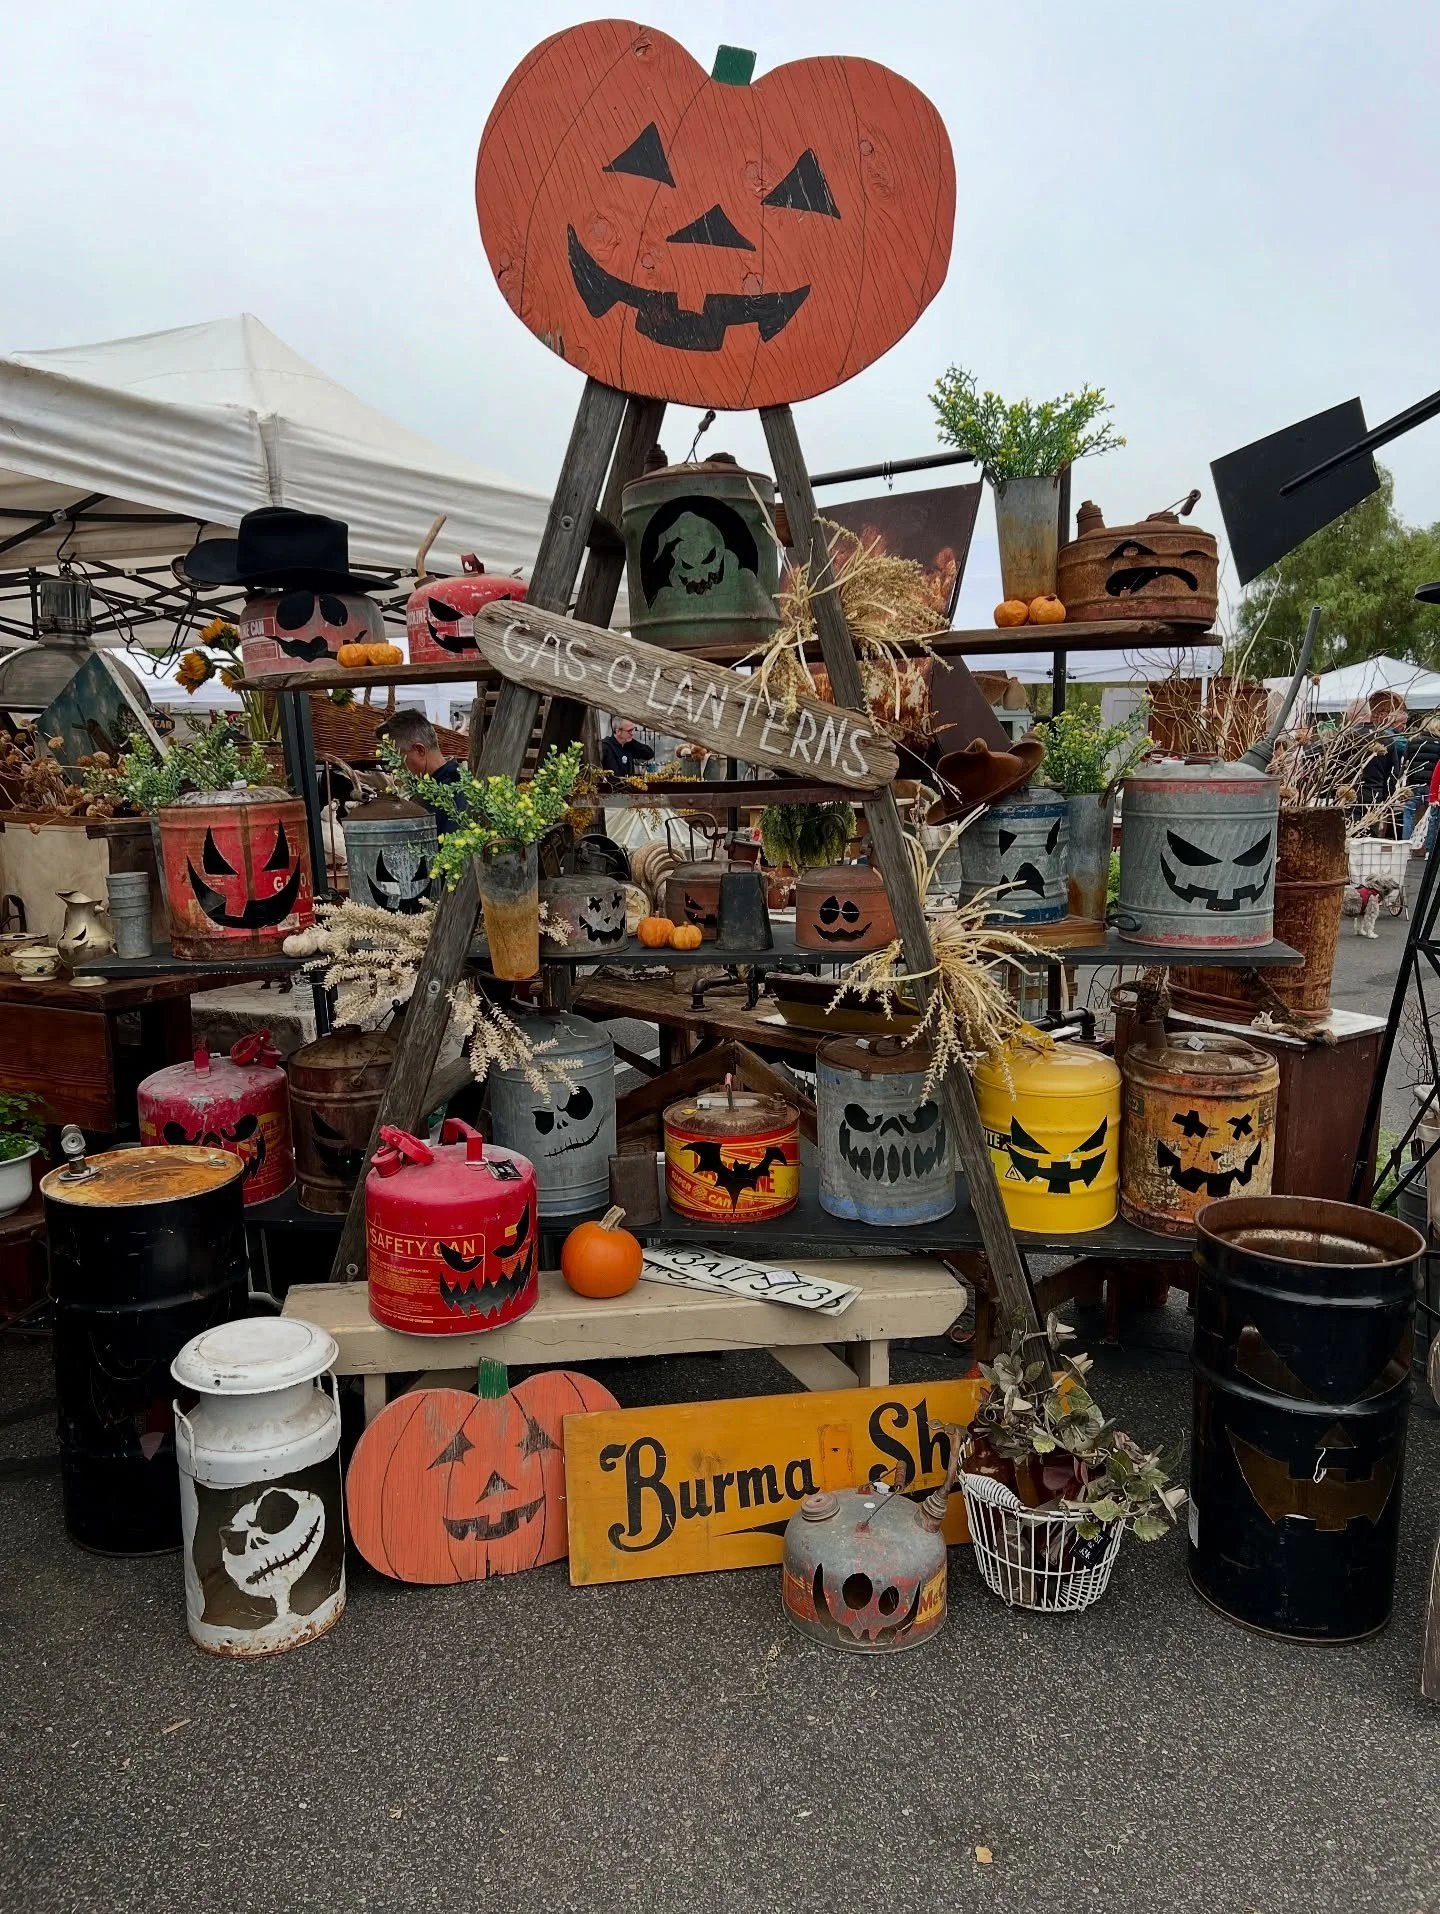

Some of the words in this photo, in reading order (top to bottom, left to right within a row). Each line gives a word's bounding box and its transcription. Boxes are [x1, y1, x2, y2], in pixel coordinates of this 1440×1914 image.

[671, 1170, 692, 1192] SUPER
[370, 1228, 428, 1256] SAFETY
[599, 1436, 821, 1553] Burma
